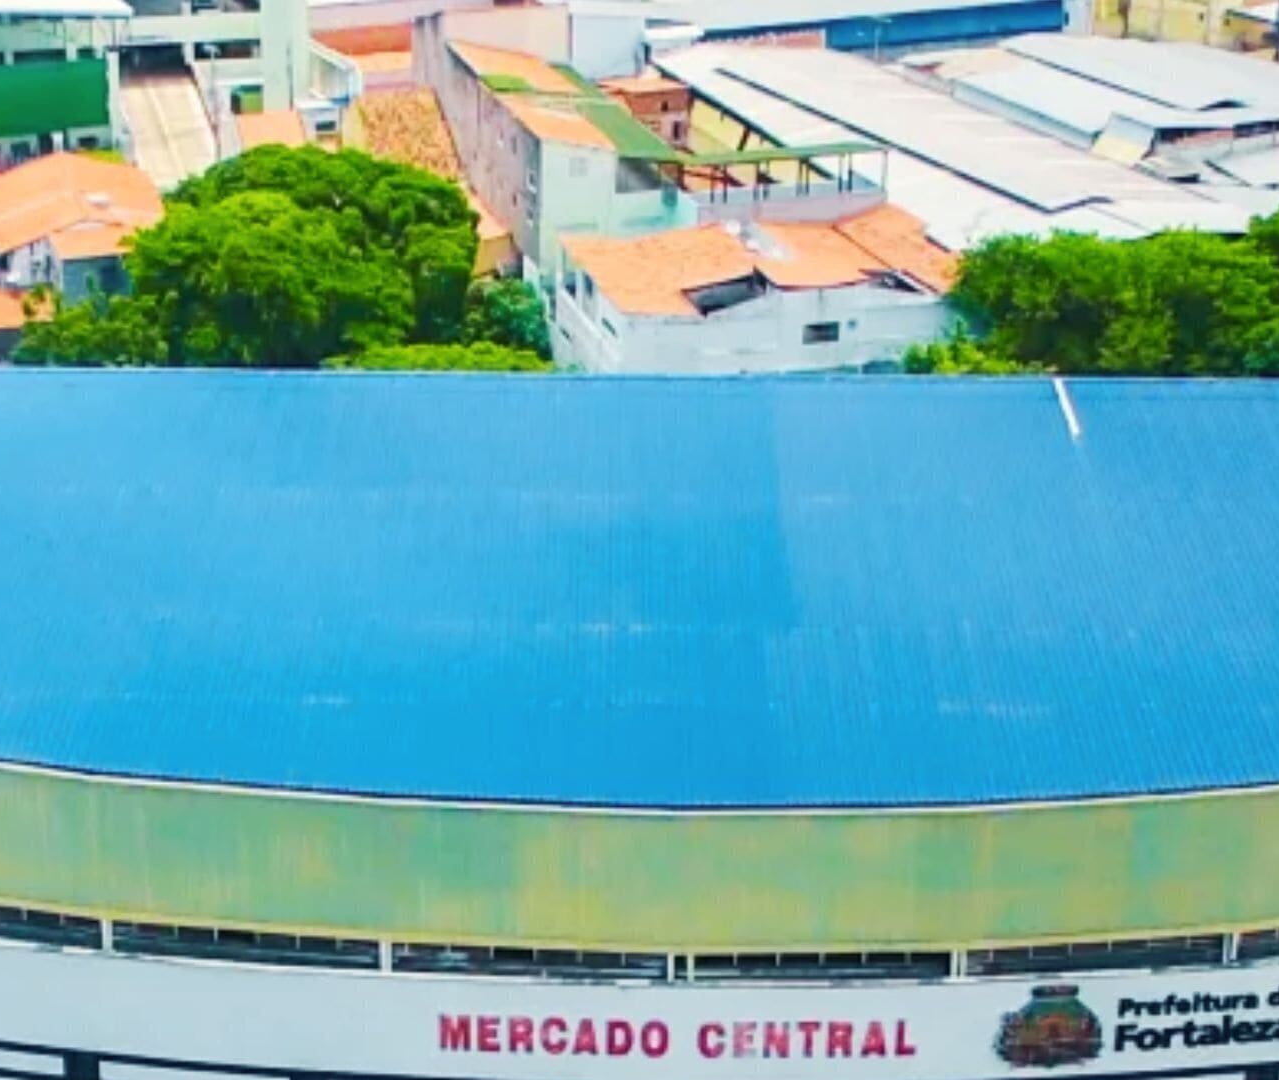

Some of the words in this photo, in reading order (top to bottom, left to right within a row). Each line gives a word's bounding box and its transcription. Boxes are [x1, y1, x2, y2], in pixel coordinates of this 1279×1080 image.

[1117, 991, 1259, 1018] Prefeitura
[437, 1014, 670, 1058] MERCADO
[696, 1019, 917, 1058] CENTRAL
